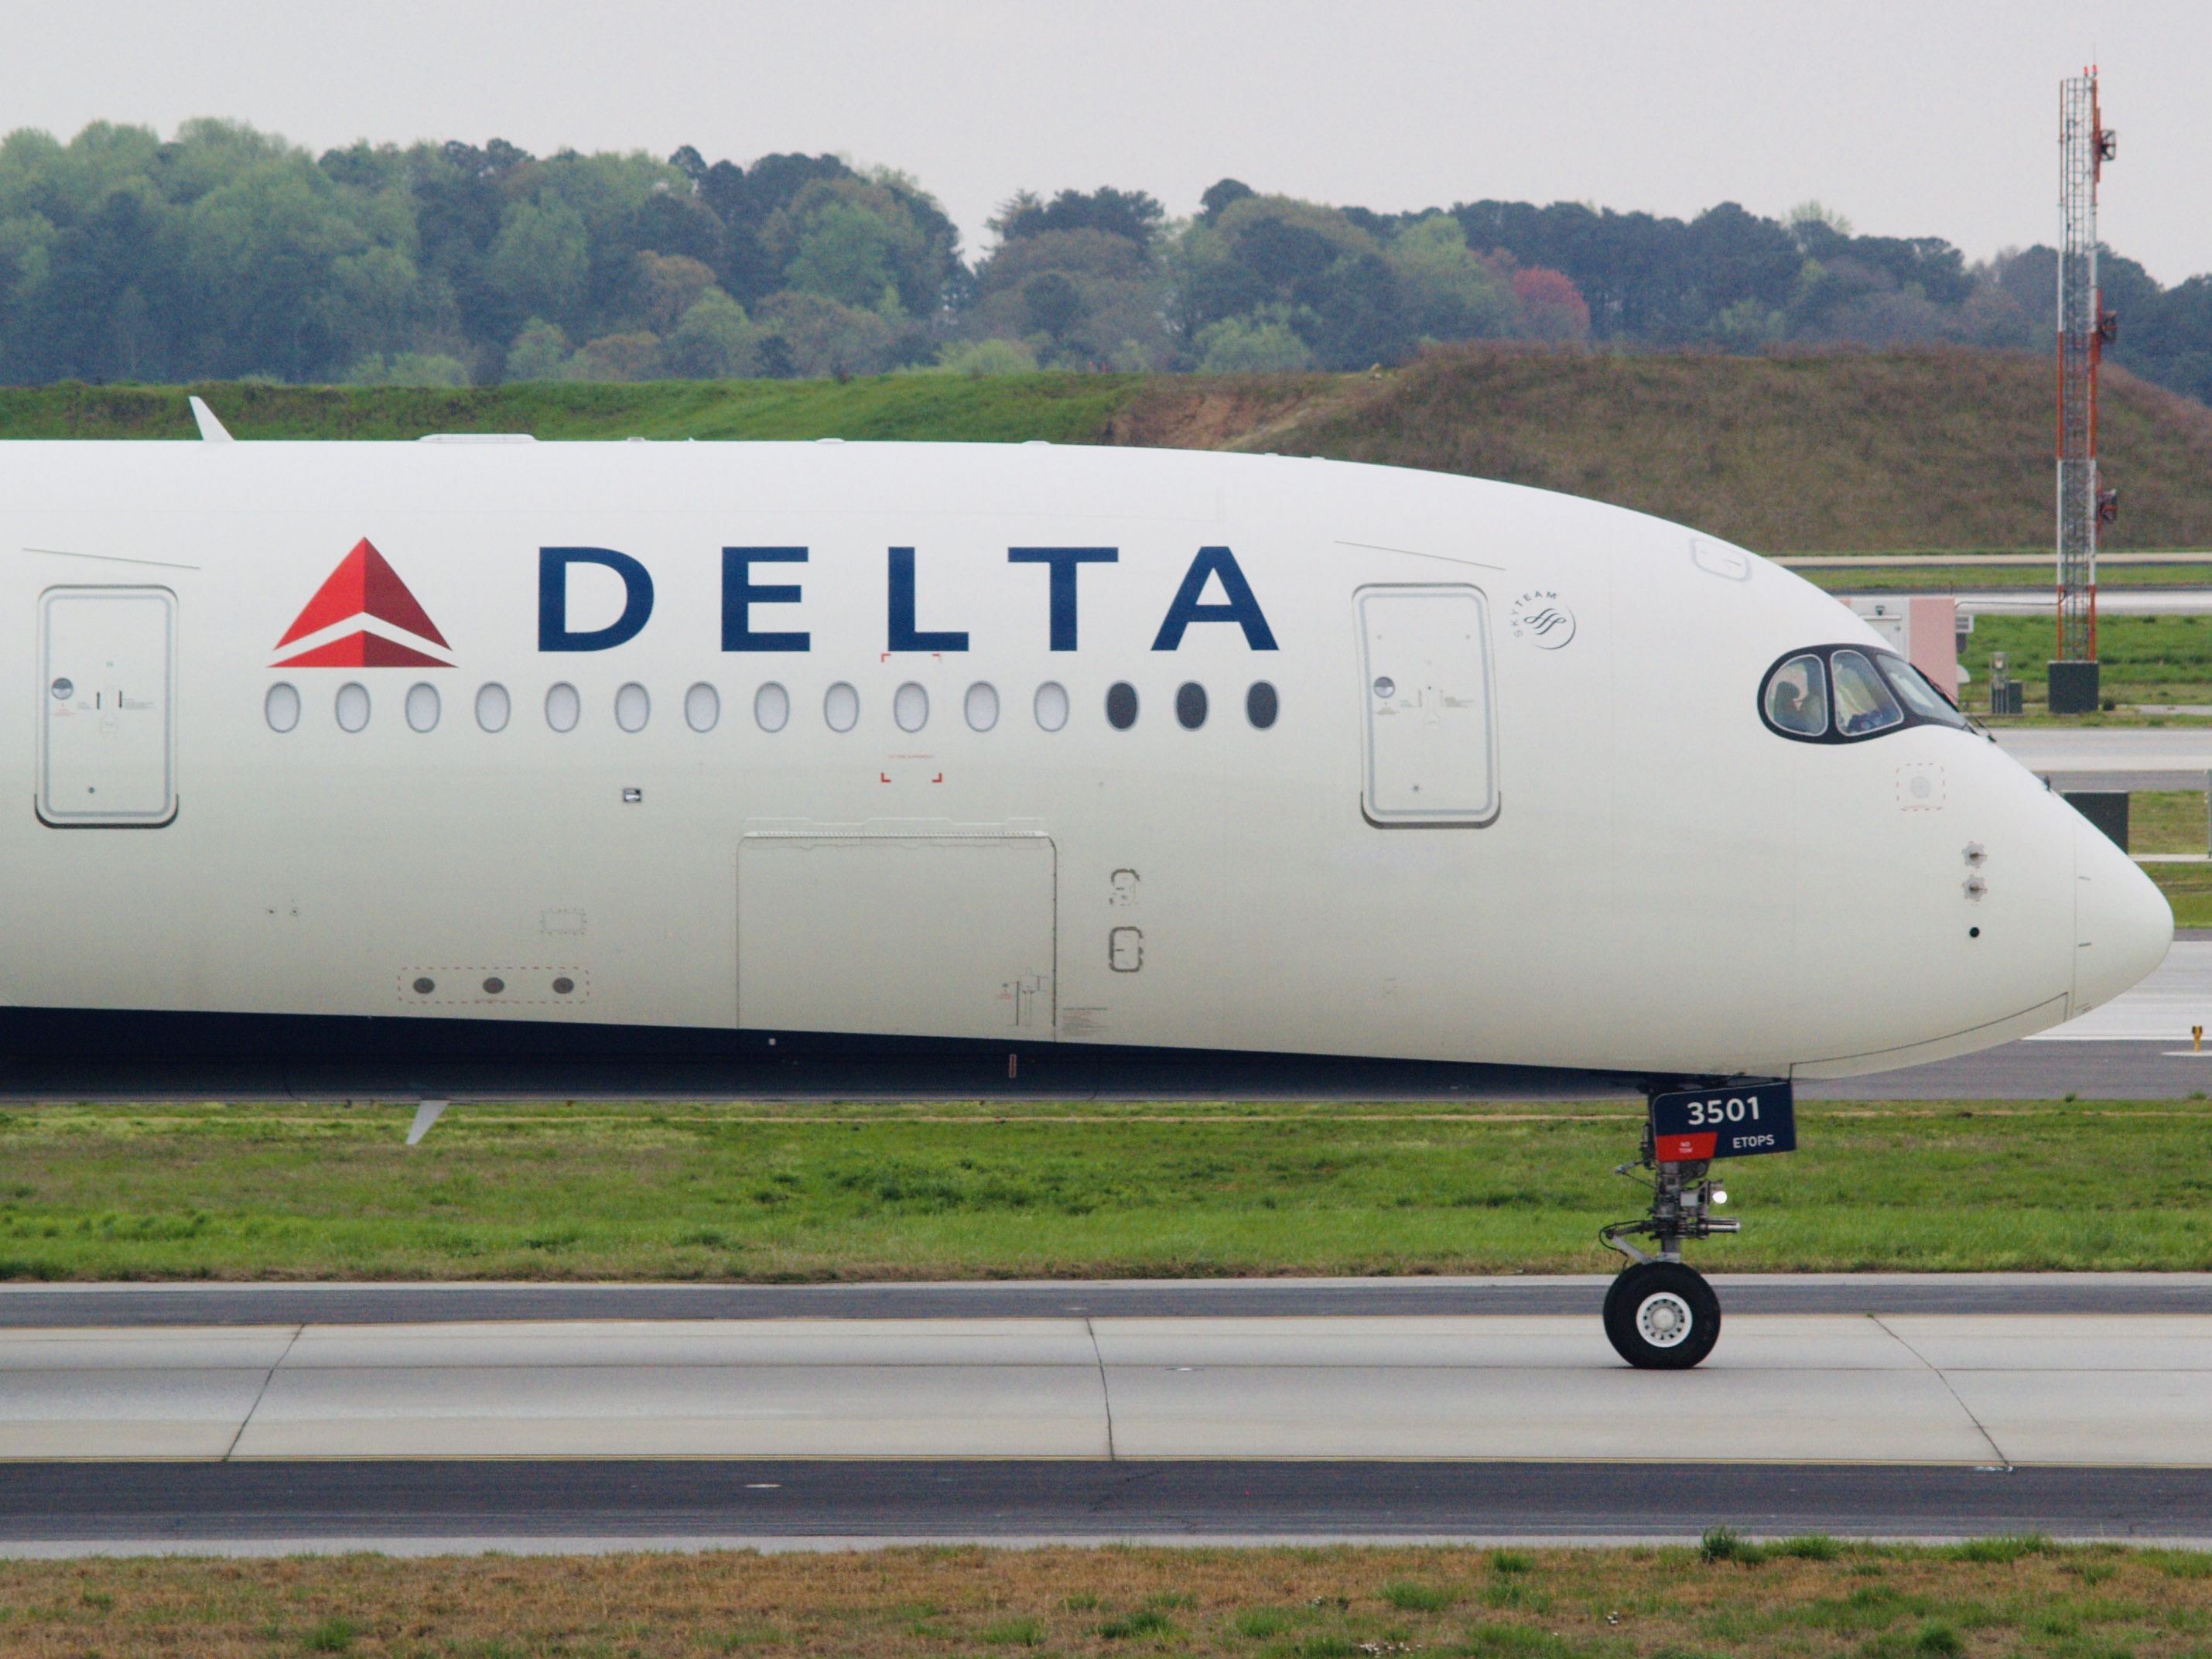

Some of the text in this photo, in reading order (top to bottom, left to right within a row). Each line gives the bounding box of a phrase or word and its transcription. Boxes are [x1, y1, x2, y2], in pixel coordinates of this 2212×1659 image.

[538, 546, 1279, 652] DELTA
[1510, 590, 1557, 638] SKYTEAM
[1687, 1096, 1760, 1126] 3501
[1732, 1134, 1775, 1149] ETOPS
